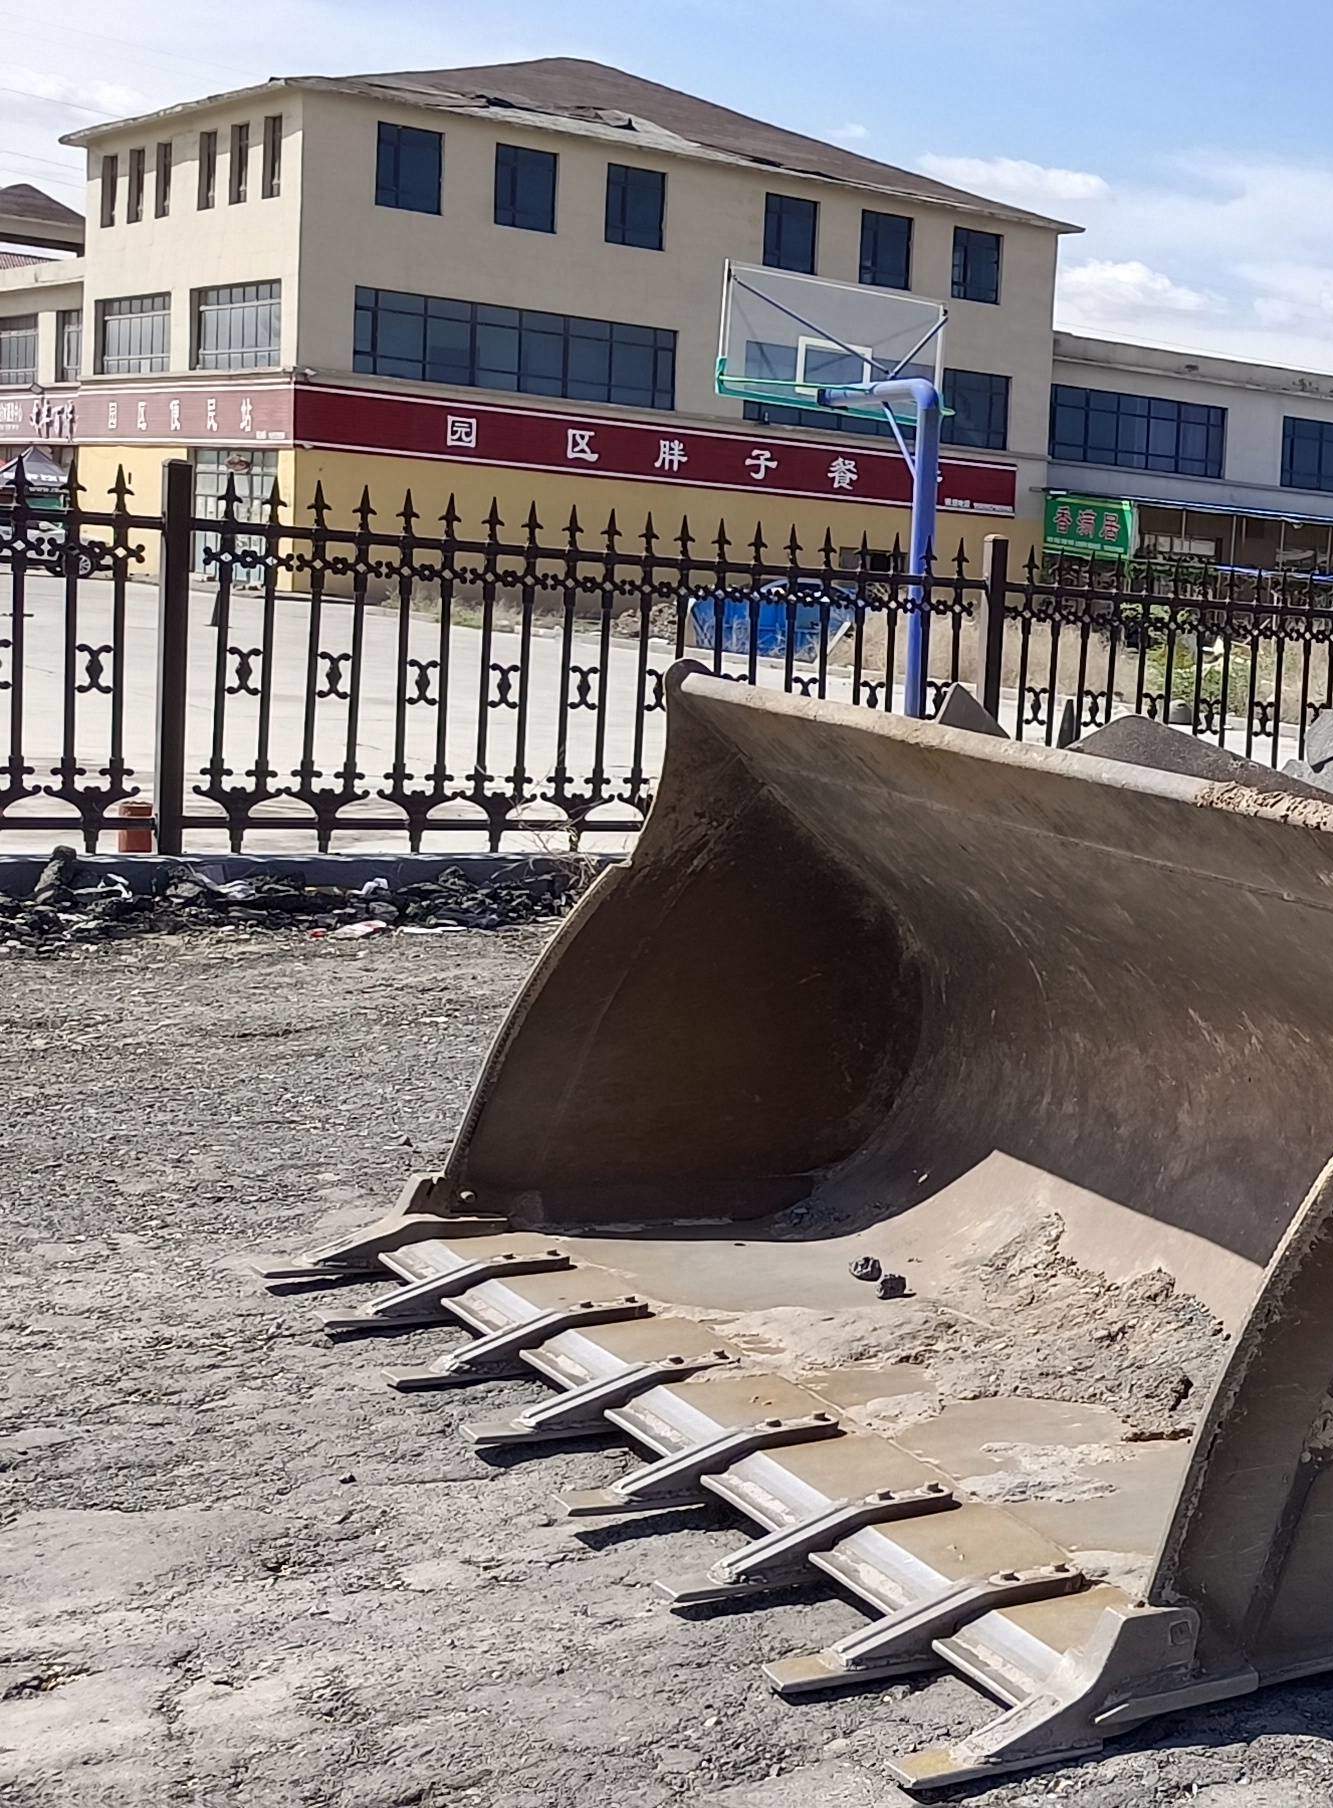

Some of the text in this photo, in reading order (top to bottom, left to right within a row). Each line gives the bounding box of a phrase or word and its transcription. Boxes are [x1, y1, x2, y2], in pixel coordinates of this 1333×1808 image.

[446, 415, 943, 490] 园区胖子餐
